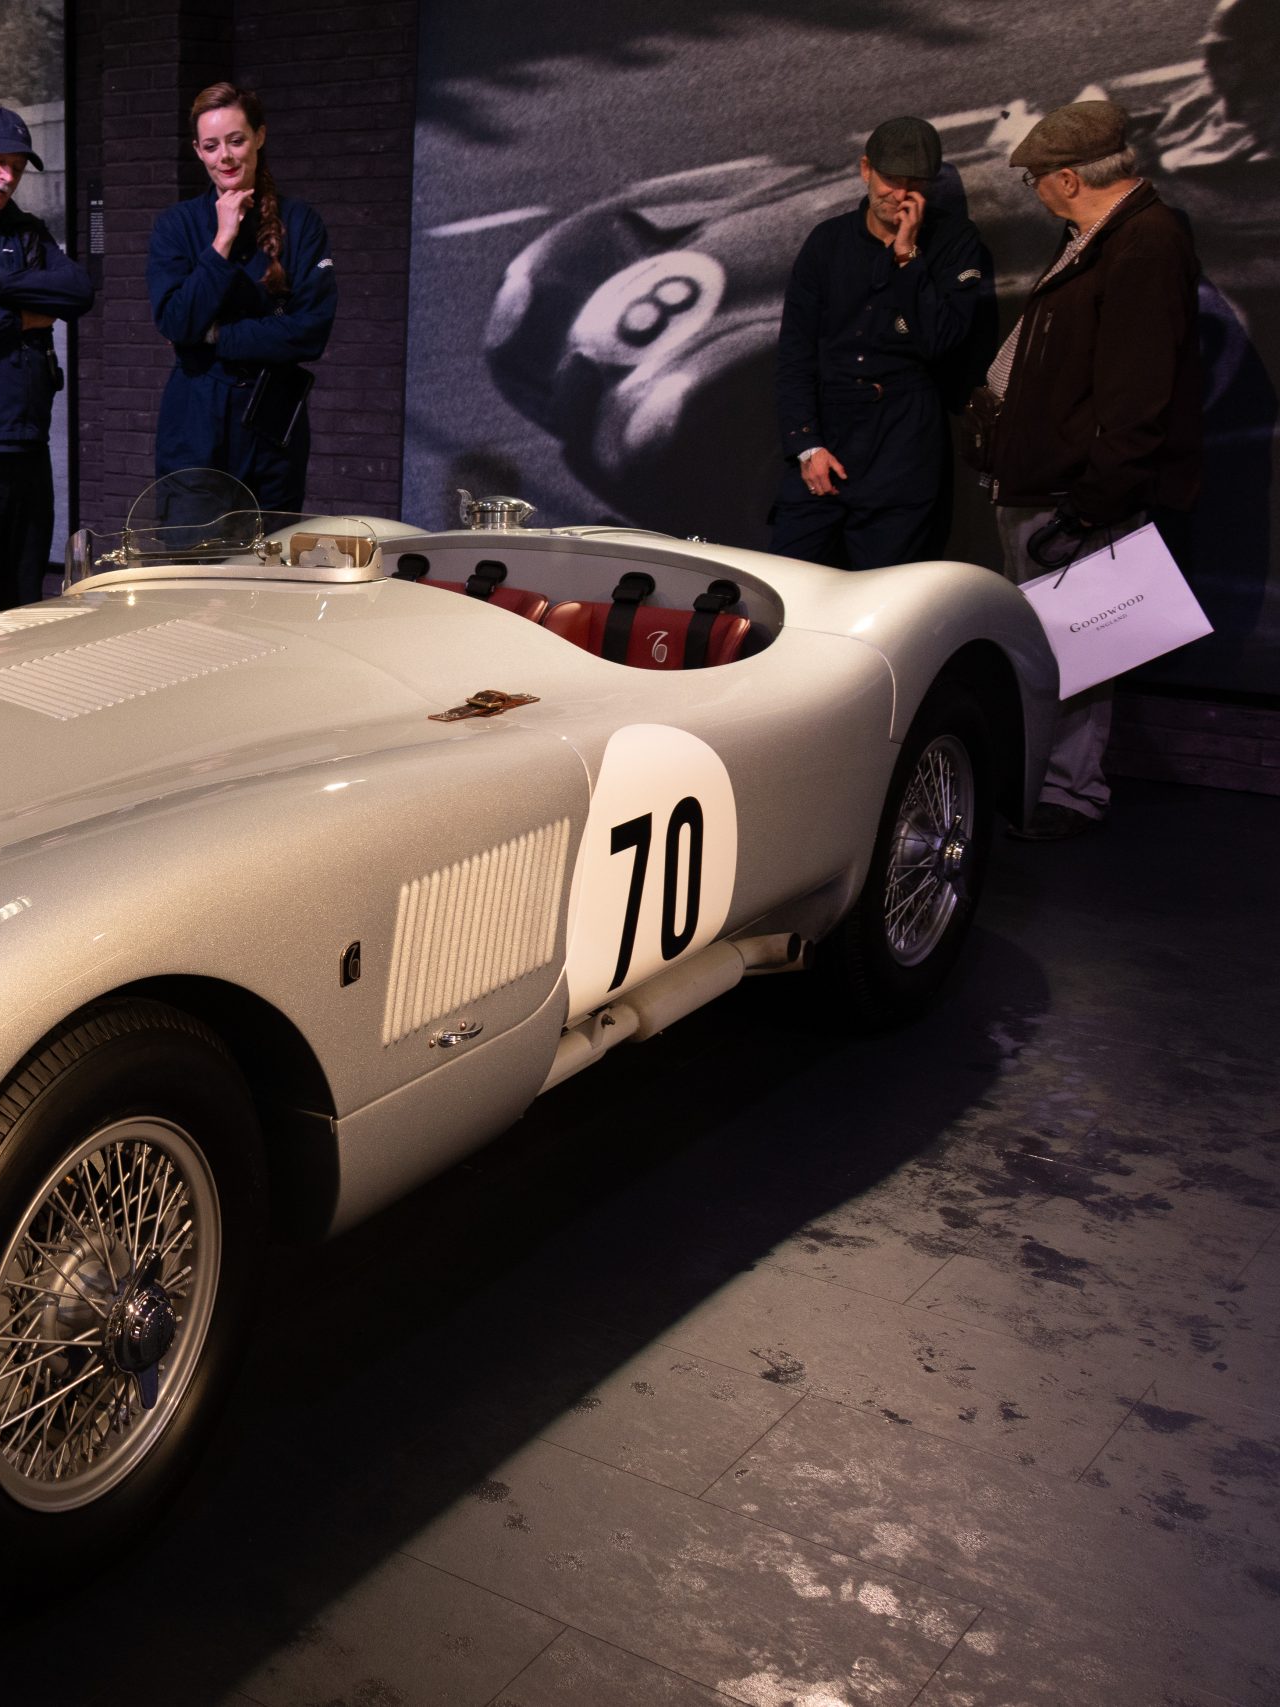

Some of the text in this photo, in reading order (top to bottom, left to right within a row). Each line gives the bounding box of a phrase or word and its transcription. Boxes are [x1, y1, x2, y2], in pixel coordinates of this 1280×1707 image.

[617, 276, 702, 348] 8
[1069, 594, 1145, 633] GOODWOOD
[607, 796, 704, 993] 70
